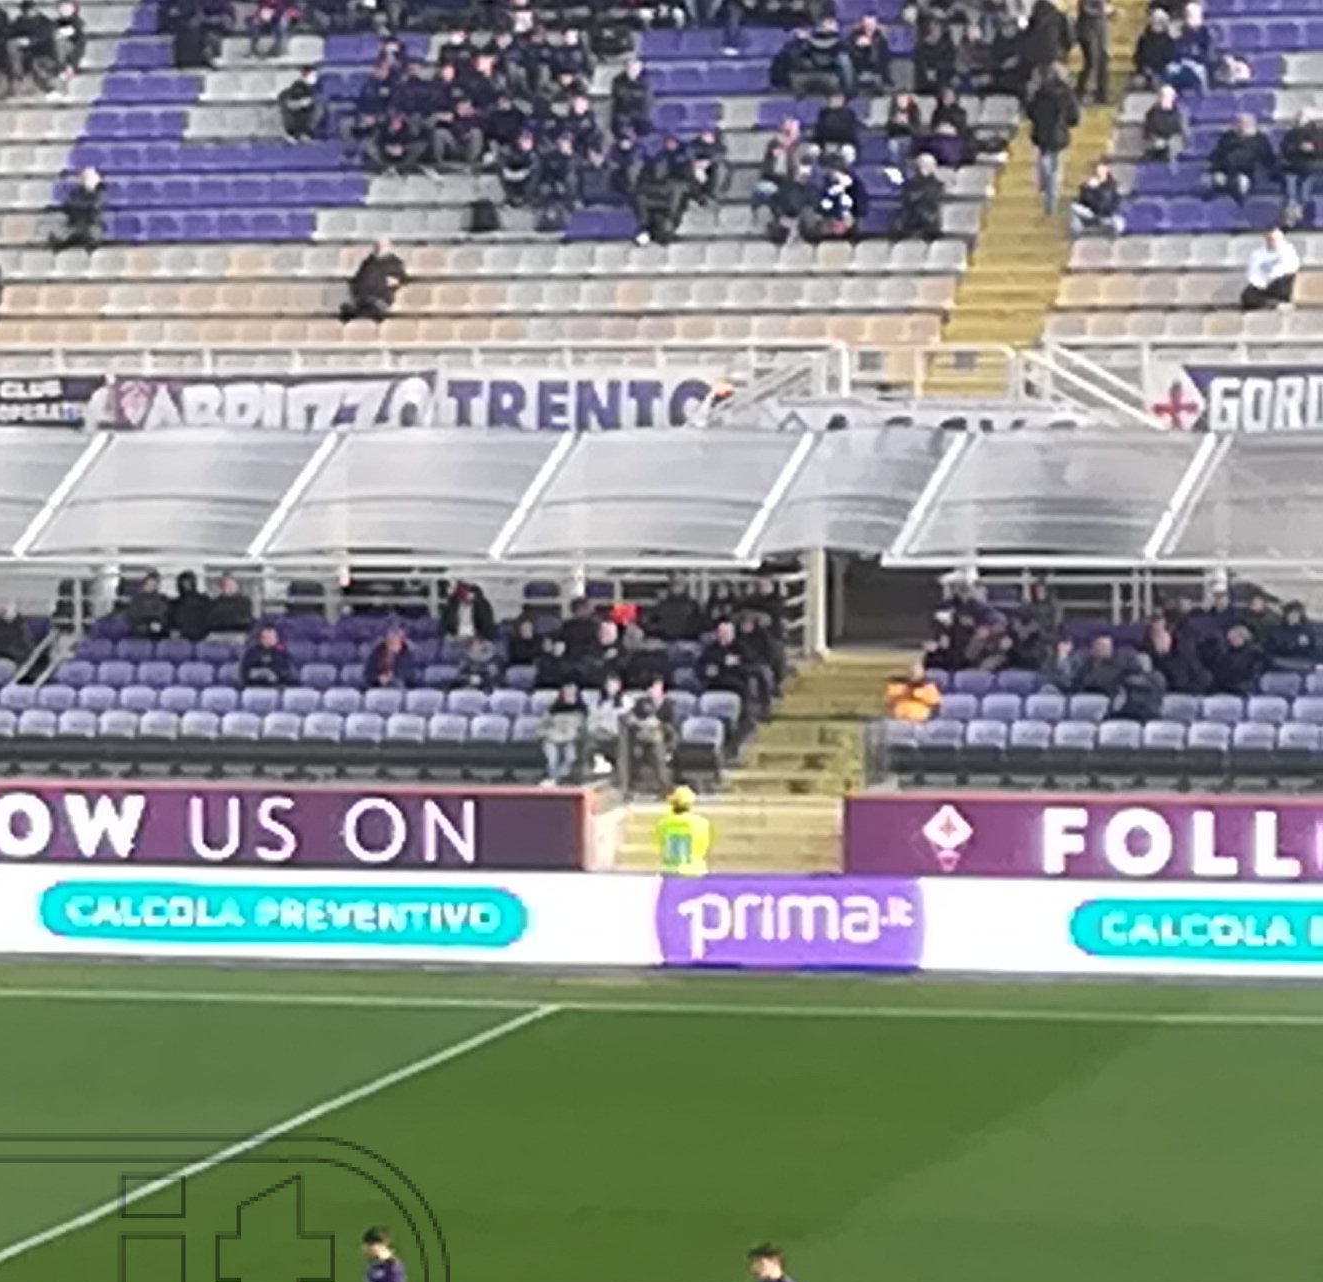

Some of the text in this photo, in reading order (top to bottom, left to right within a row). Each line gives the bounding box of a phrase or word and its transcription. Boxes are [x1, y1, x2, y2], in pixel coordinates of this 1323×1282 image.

[0, 379, 63, 399] CLUB
[187, 796, 298, 862] US
[344, 797, 478, 864] ON
[1041, 807, 1323, 877] FOLL
[65, 894, 502, 934] CALCOLA PREVENTIVO
[1101, 910, 1298, 947] CALCOLA
